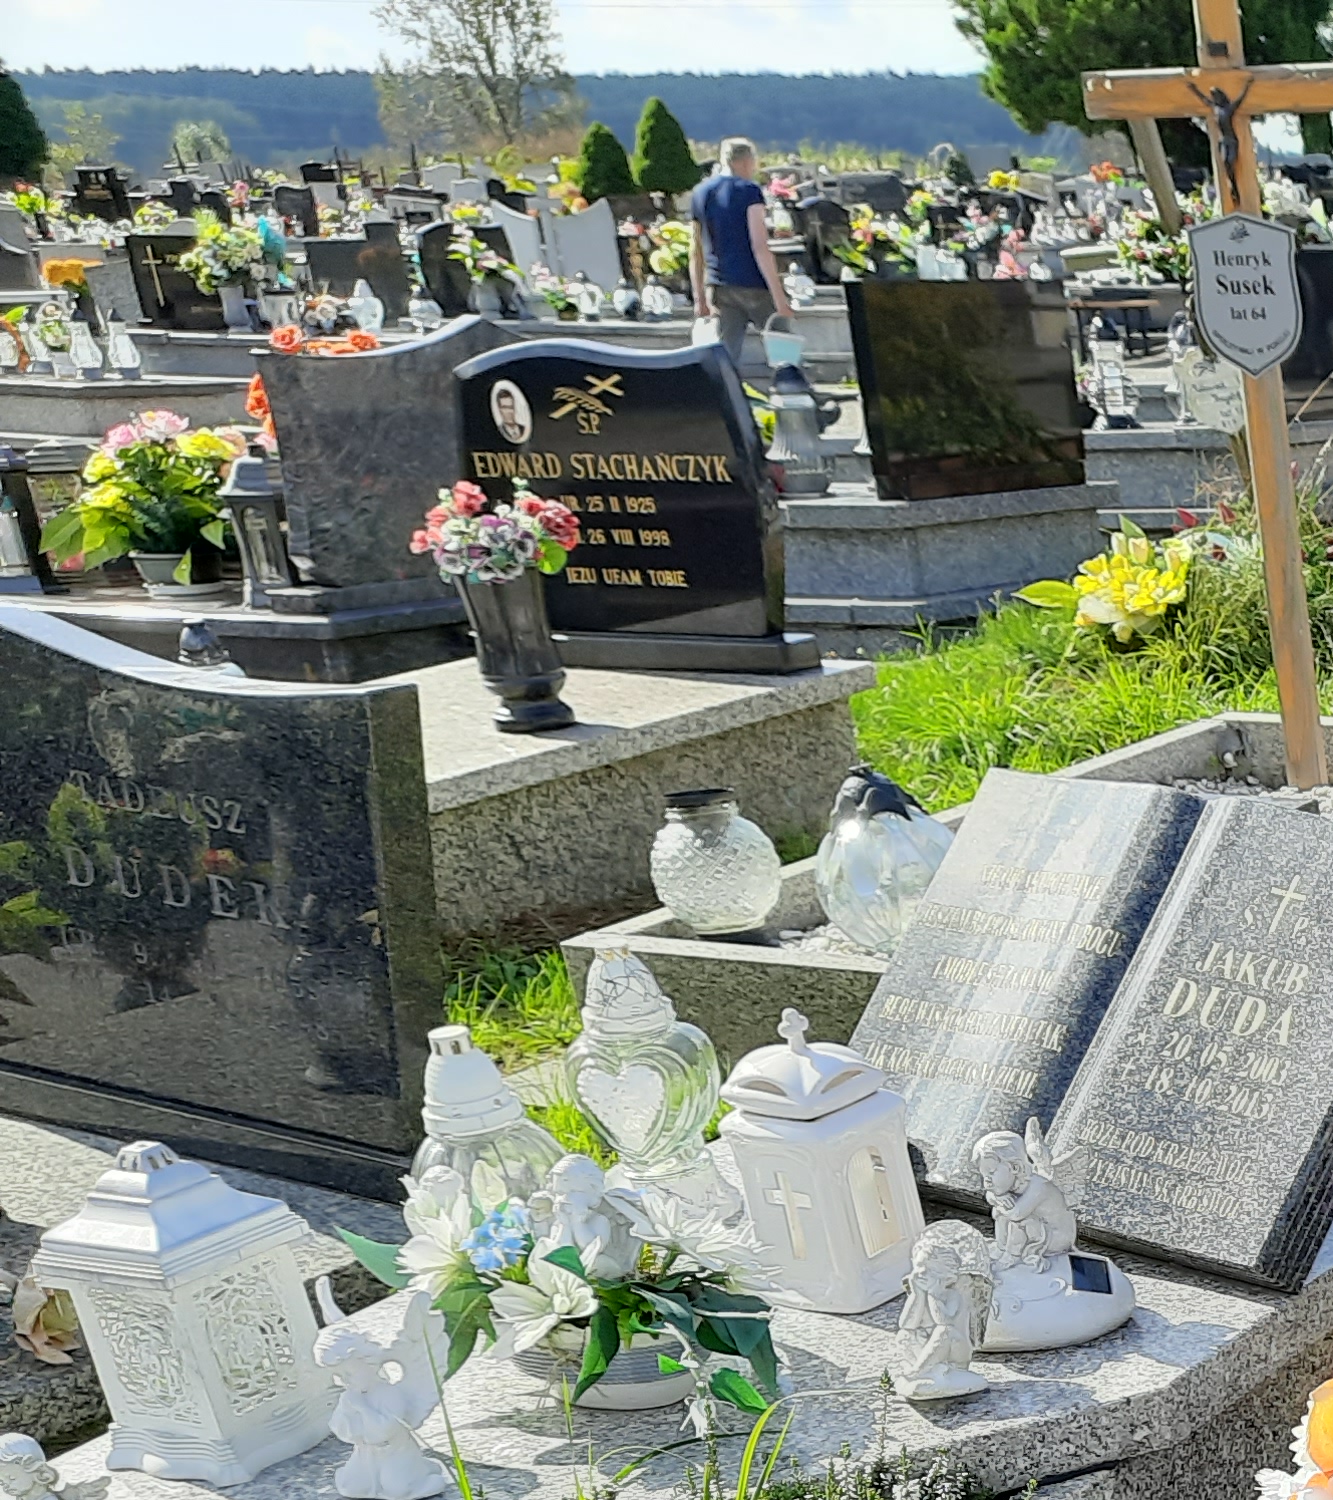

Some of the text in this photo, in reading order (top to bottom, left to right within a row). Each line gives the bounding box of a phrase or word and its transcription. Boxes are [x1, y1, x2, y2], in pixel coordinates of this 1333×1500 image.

[1213, 250, 1271, 270] Henryk
[1216, 273, 1276, 296] Susek
[1230, 306, 1267, 320] lat 64
[472, 451, 733, 484] EDWARD STACHAŃCZYK
[585, 495, 605, 513] 25
[608, 495, 621, 513] II
[624, 495, 658, 515] 1925
[586, 528, 607, 545] 26
[609, 528, 636, 547] VIII
[601, 567, 644, 586] UFAM
[646, 569, 690, 589] TOBIE
[69, 769, 247, 835] TADEUSZ
[66, 844, 293, 931] DUDEK
[1195, 940, 1310, 995] JAKUB
[1162, 976, 1295, 1047] DUDA
[1120, 1130, 1156, 1158] POD
